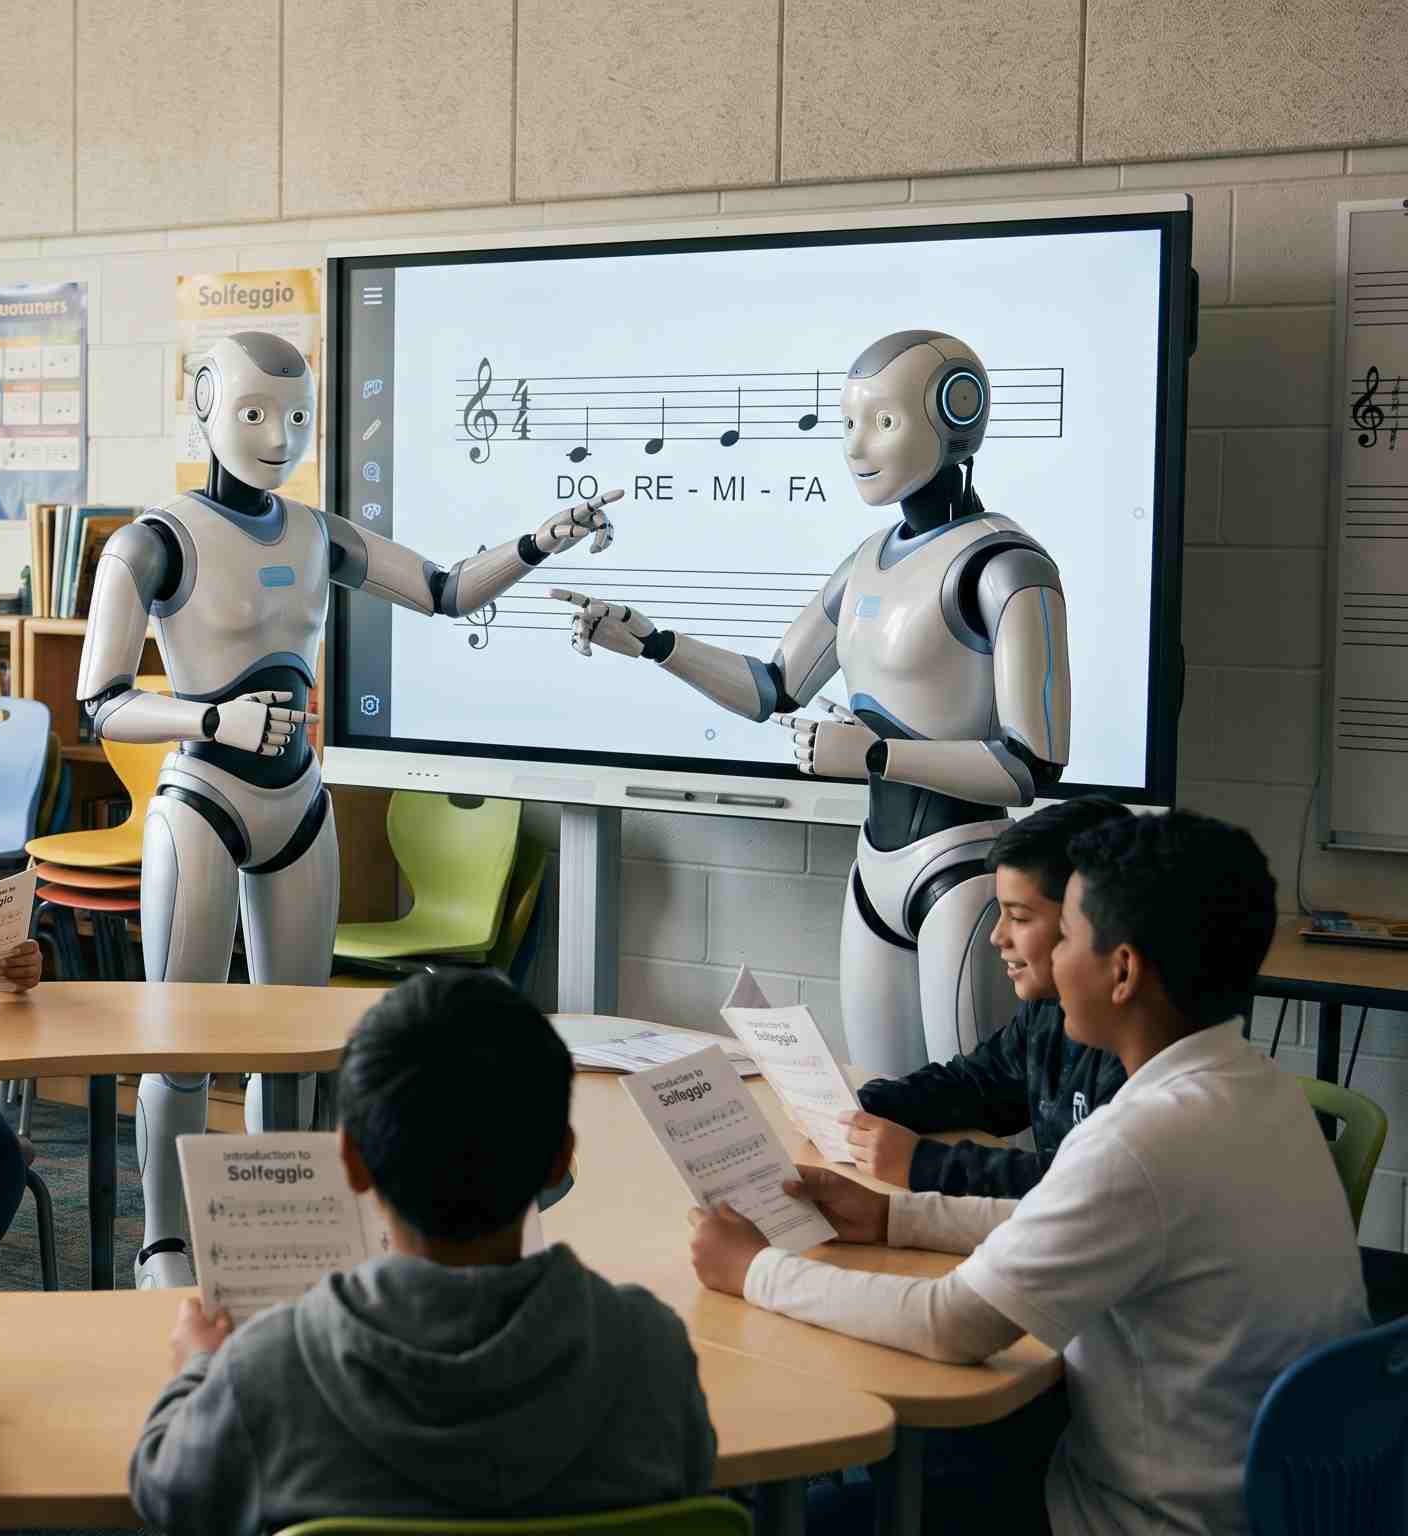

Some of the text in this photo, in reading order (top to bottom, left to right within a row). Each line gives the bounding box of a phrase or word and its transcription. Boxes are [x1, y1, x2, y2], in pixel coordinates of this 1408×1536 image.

[199, 281, 295, 308] Solfeggio
[557, 475, 599, 500] DO
[635, 476, 674, 500] RE
[714, 476, 745, 501] MI
[789, 476, 827, 502] FA
[227, 1164, 314, 1184] Solfeggio
